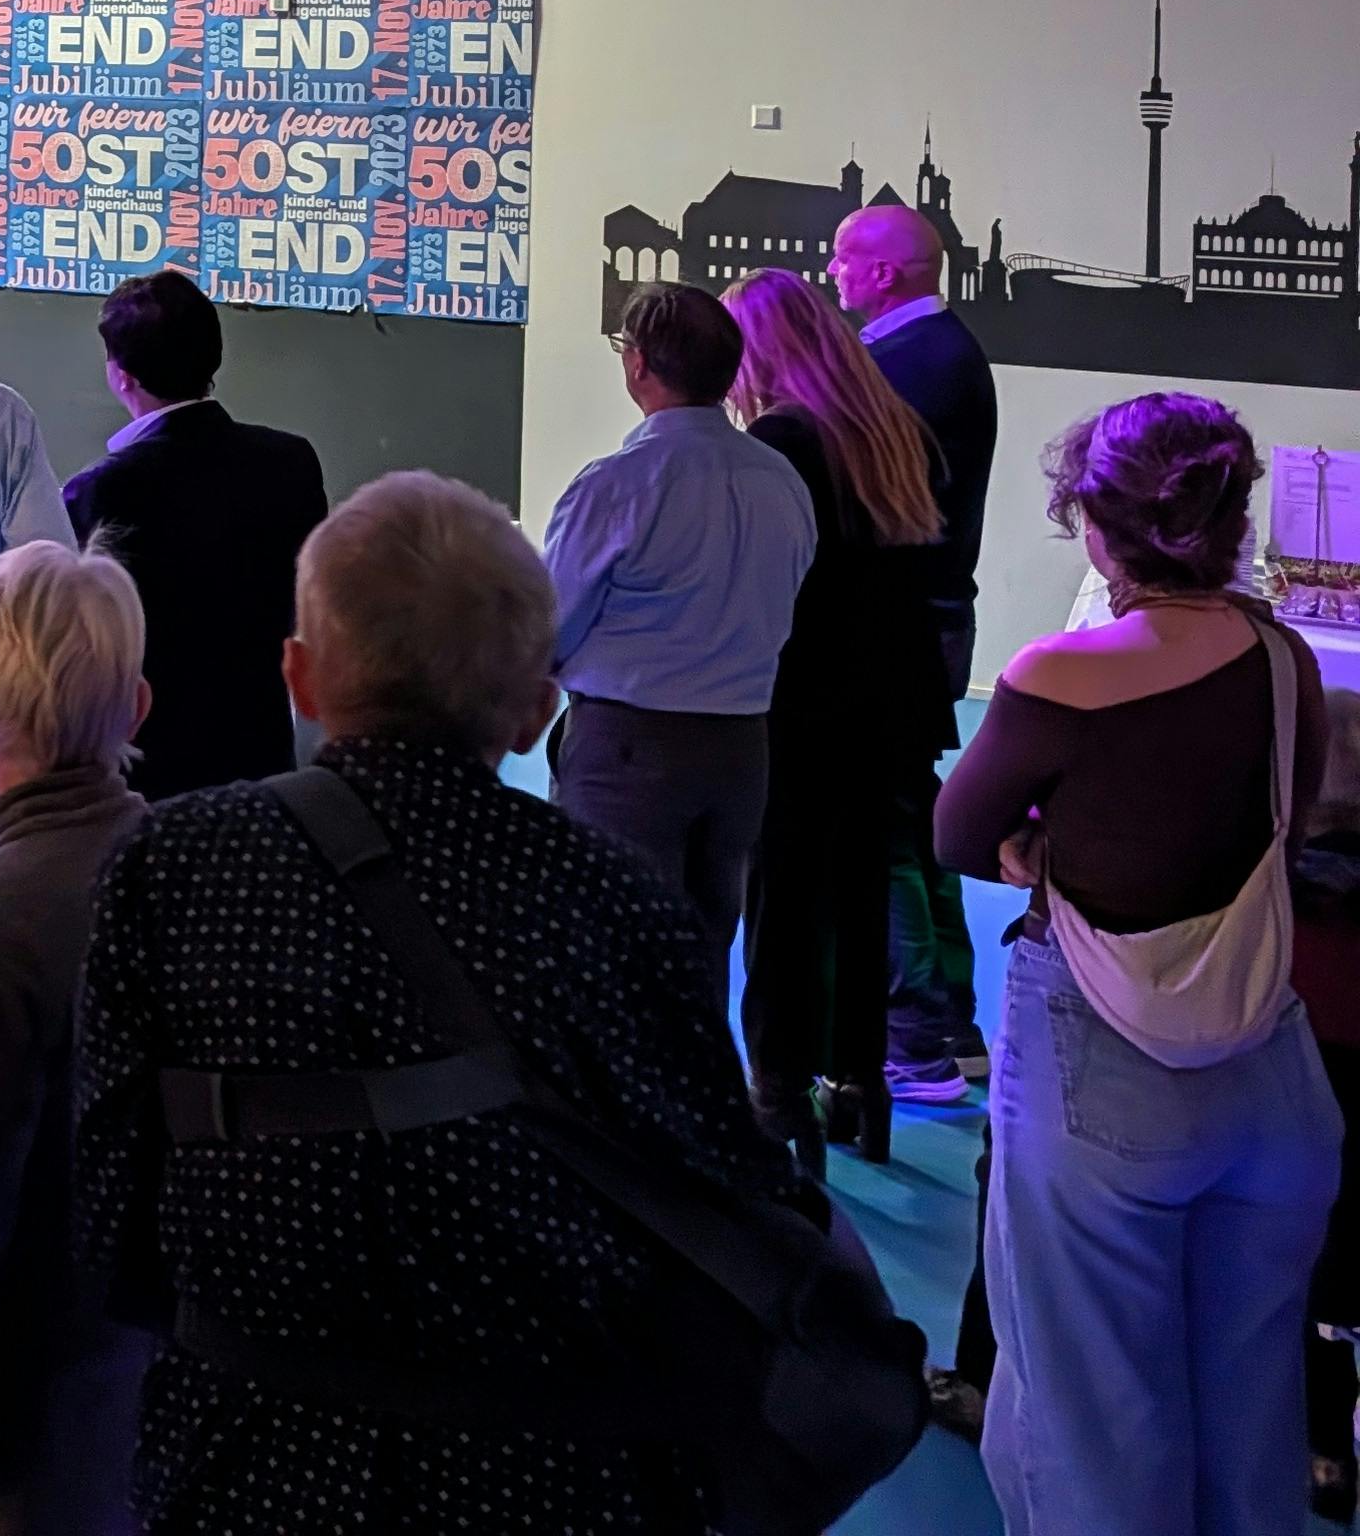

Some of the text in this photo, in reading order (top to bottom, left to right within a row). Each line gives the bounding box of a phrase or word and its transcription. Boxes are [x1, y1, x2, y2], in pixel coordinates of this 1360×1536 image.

[90, 2, 167, 16] jugendhaus
[29, 19, 45, 62] 1973
[48, 15, 166, 65] END
[221, 22, 239, 67] 1973
[242, 19, 369, 71] END
[428, 24, 446, 73] 1973
[450, 21, 532, 75] EN
[13, 65, 163, 97] Jubiläum
[168, 53, 203, 94] 17.
[206, 70, 367, 104] Jubiläum
[372, 58, 408, 100] 17.
[14, 100, 167, 138] wir feiern
[208, 106, 371, 147] wir feiern
[414, 114, 479, 143] wir
[10, 182, 79, 208] Jahre
[85, 185, 162, 201] kinder- und
[164, 108, 200, 248] NOV. 2023
[84, 199, 162, 213] jugendhaus
[202, 191, 277, 218] Jahre
[283, 194, 367, 210] kinder- und
[283, 207, 367, 222] jugendhaus
[368, 114, 407, 306] 17. NOV. 2023
[409, 202, 488, 229] Jahre
[496, 205, 528, 219] kind
[24, 210, 40, 255] 1973
[43, 208, 161, 262] END
[218, 222, 235, 267] 1973
[494, 219, 527, 232] juge
[238, 219, 366, 276] END
[424, 233, 442, 280] 1973
[446, 230, 528, 286] EN
[204, 269, 362, 311] Jubiläum
